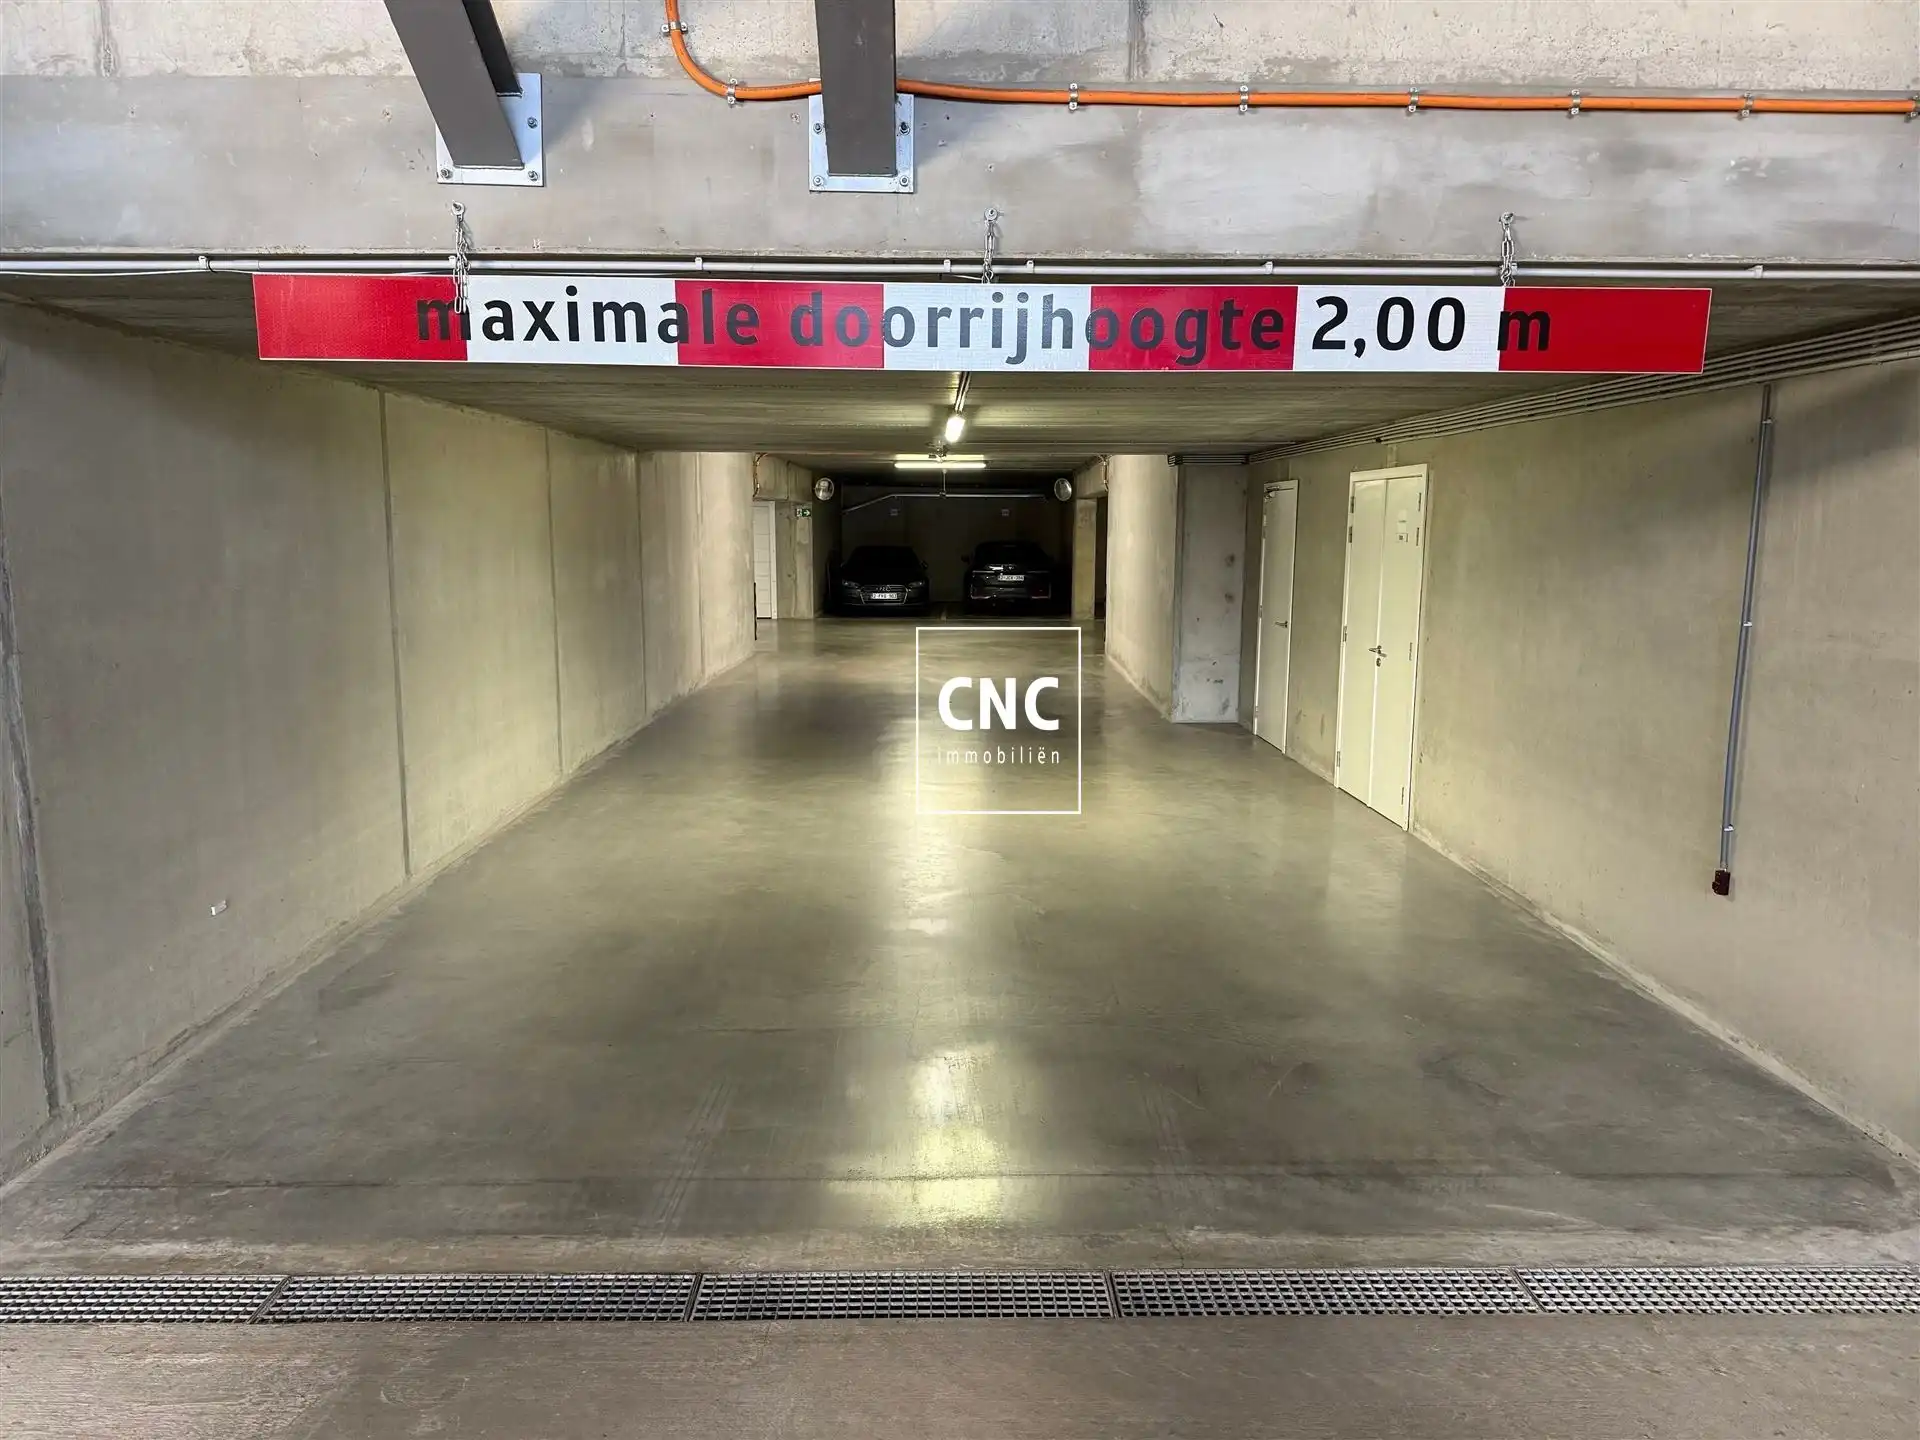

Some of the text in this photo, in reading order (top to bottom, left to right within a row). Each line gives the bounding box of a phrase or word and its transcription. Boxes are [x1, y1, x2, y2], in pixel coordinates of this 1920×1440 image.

[416, 284, 1551, 366] maximale doorrijhoogte 2,00 m
